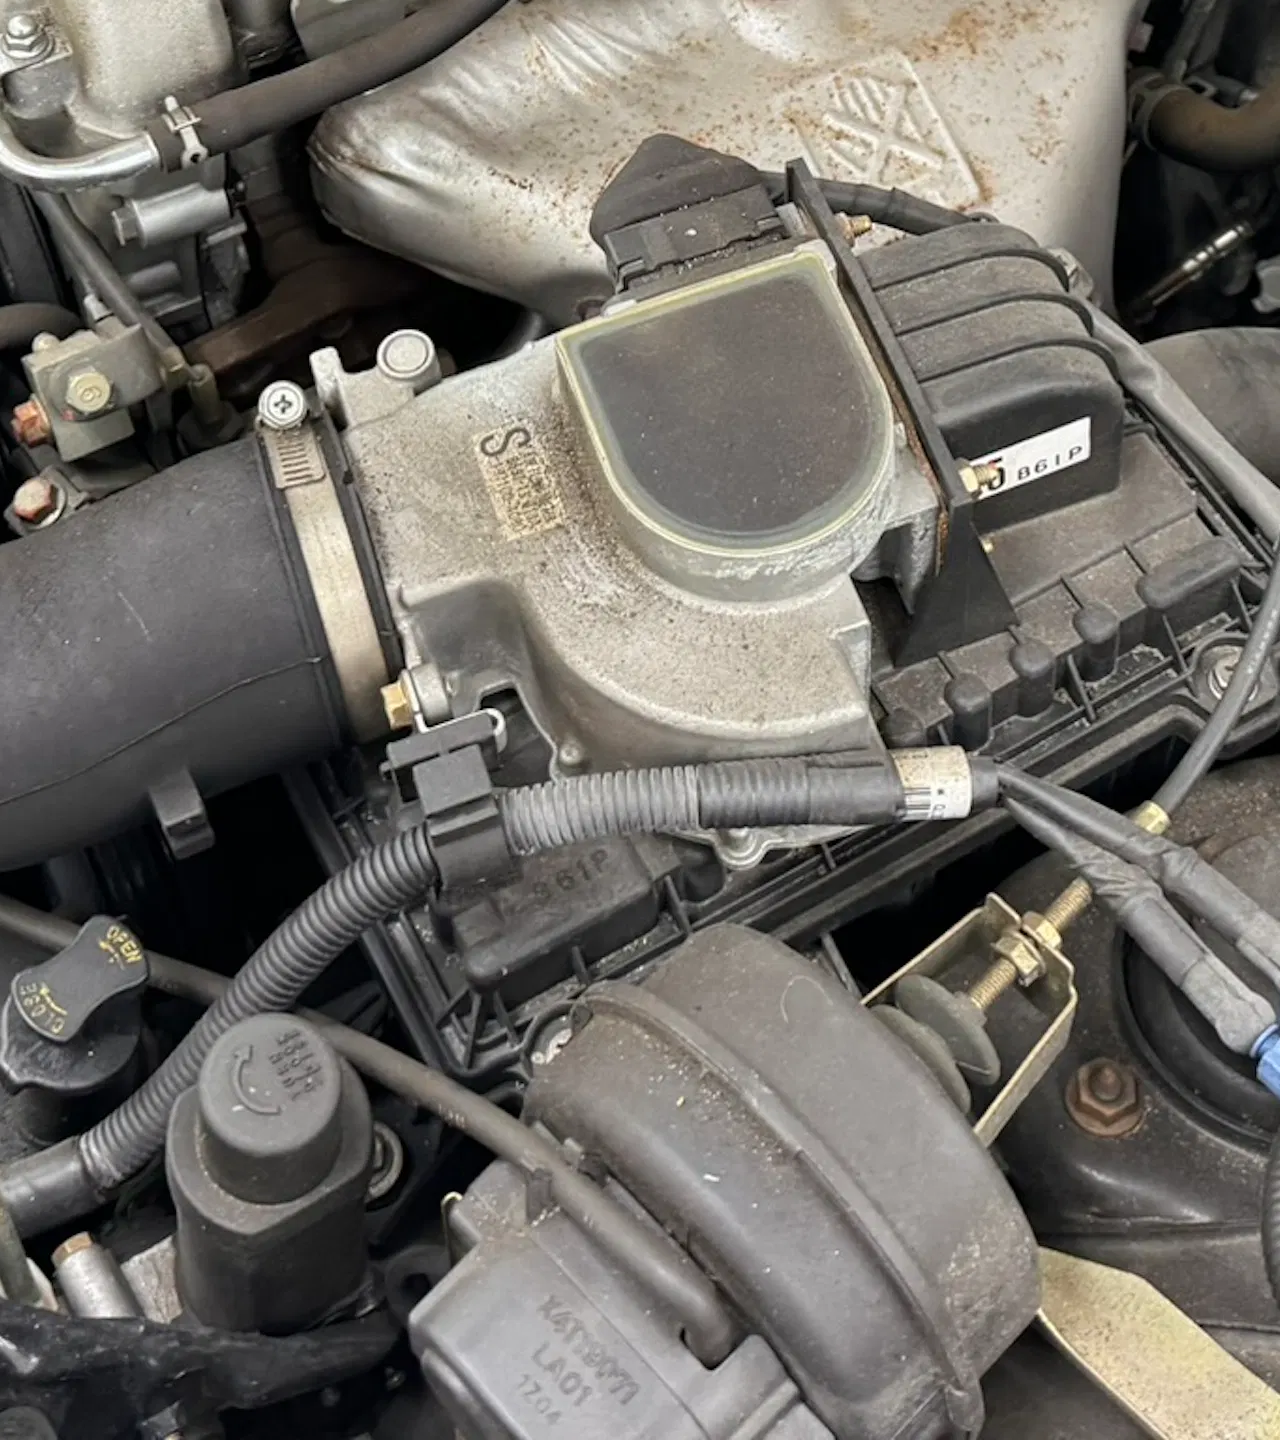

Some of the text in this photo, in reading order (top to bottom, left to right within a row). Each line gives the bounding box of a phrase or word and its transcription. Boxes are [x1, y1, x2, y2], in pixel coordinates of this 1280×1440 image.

[480, 426, 531, 459] S
[1017, 446, 1083, 481] B61P
[107, 925, 143, 964] OPEN
[20, 982, 66, 1035] CLOSE
